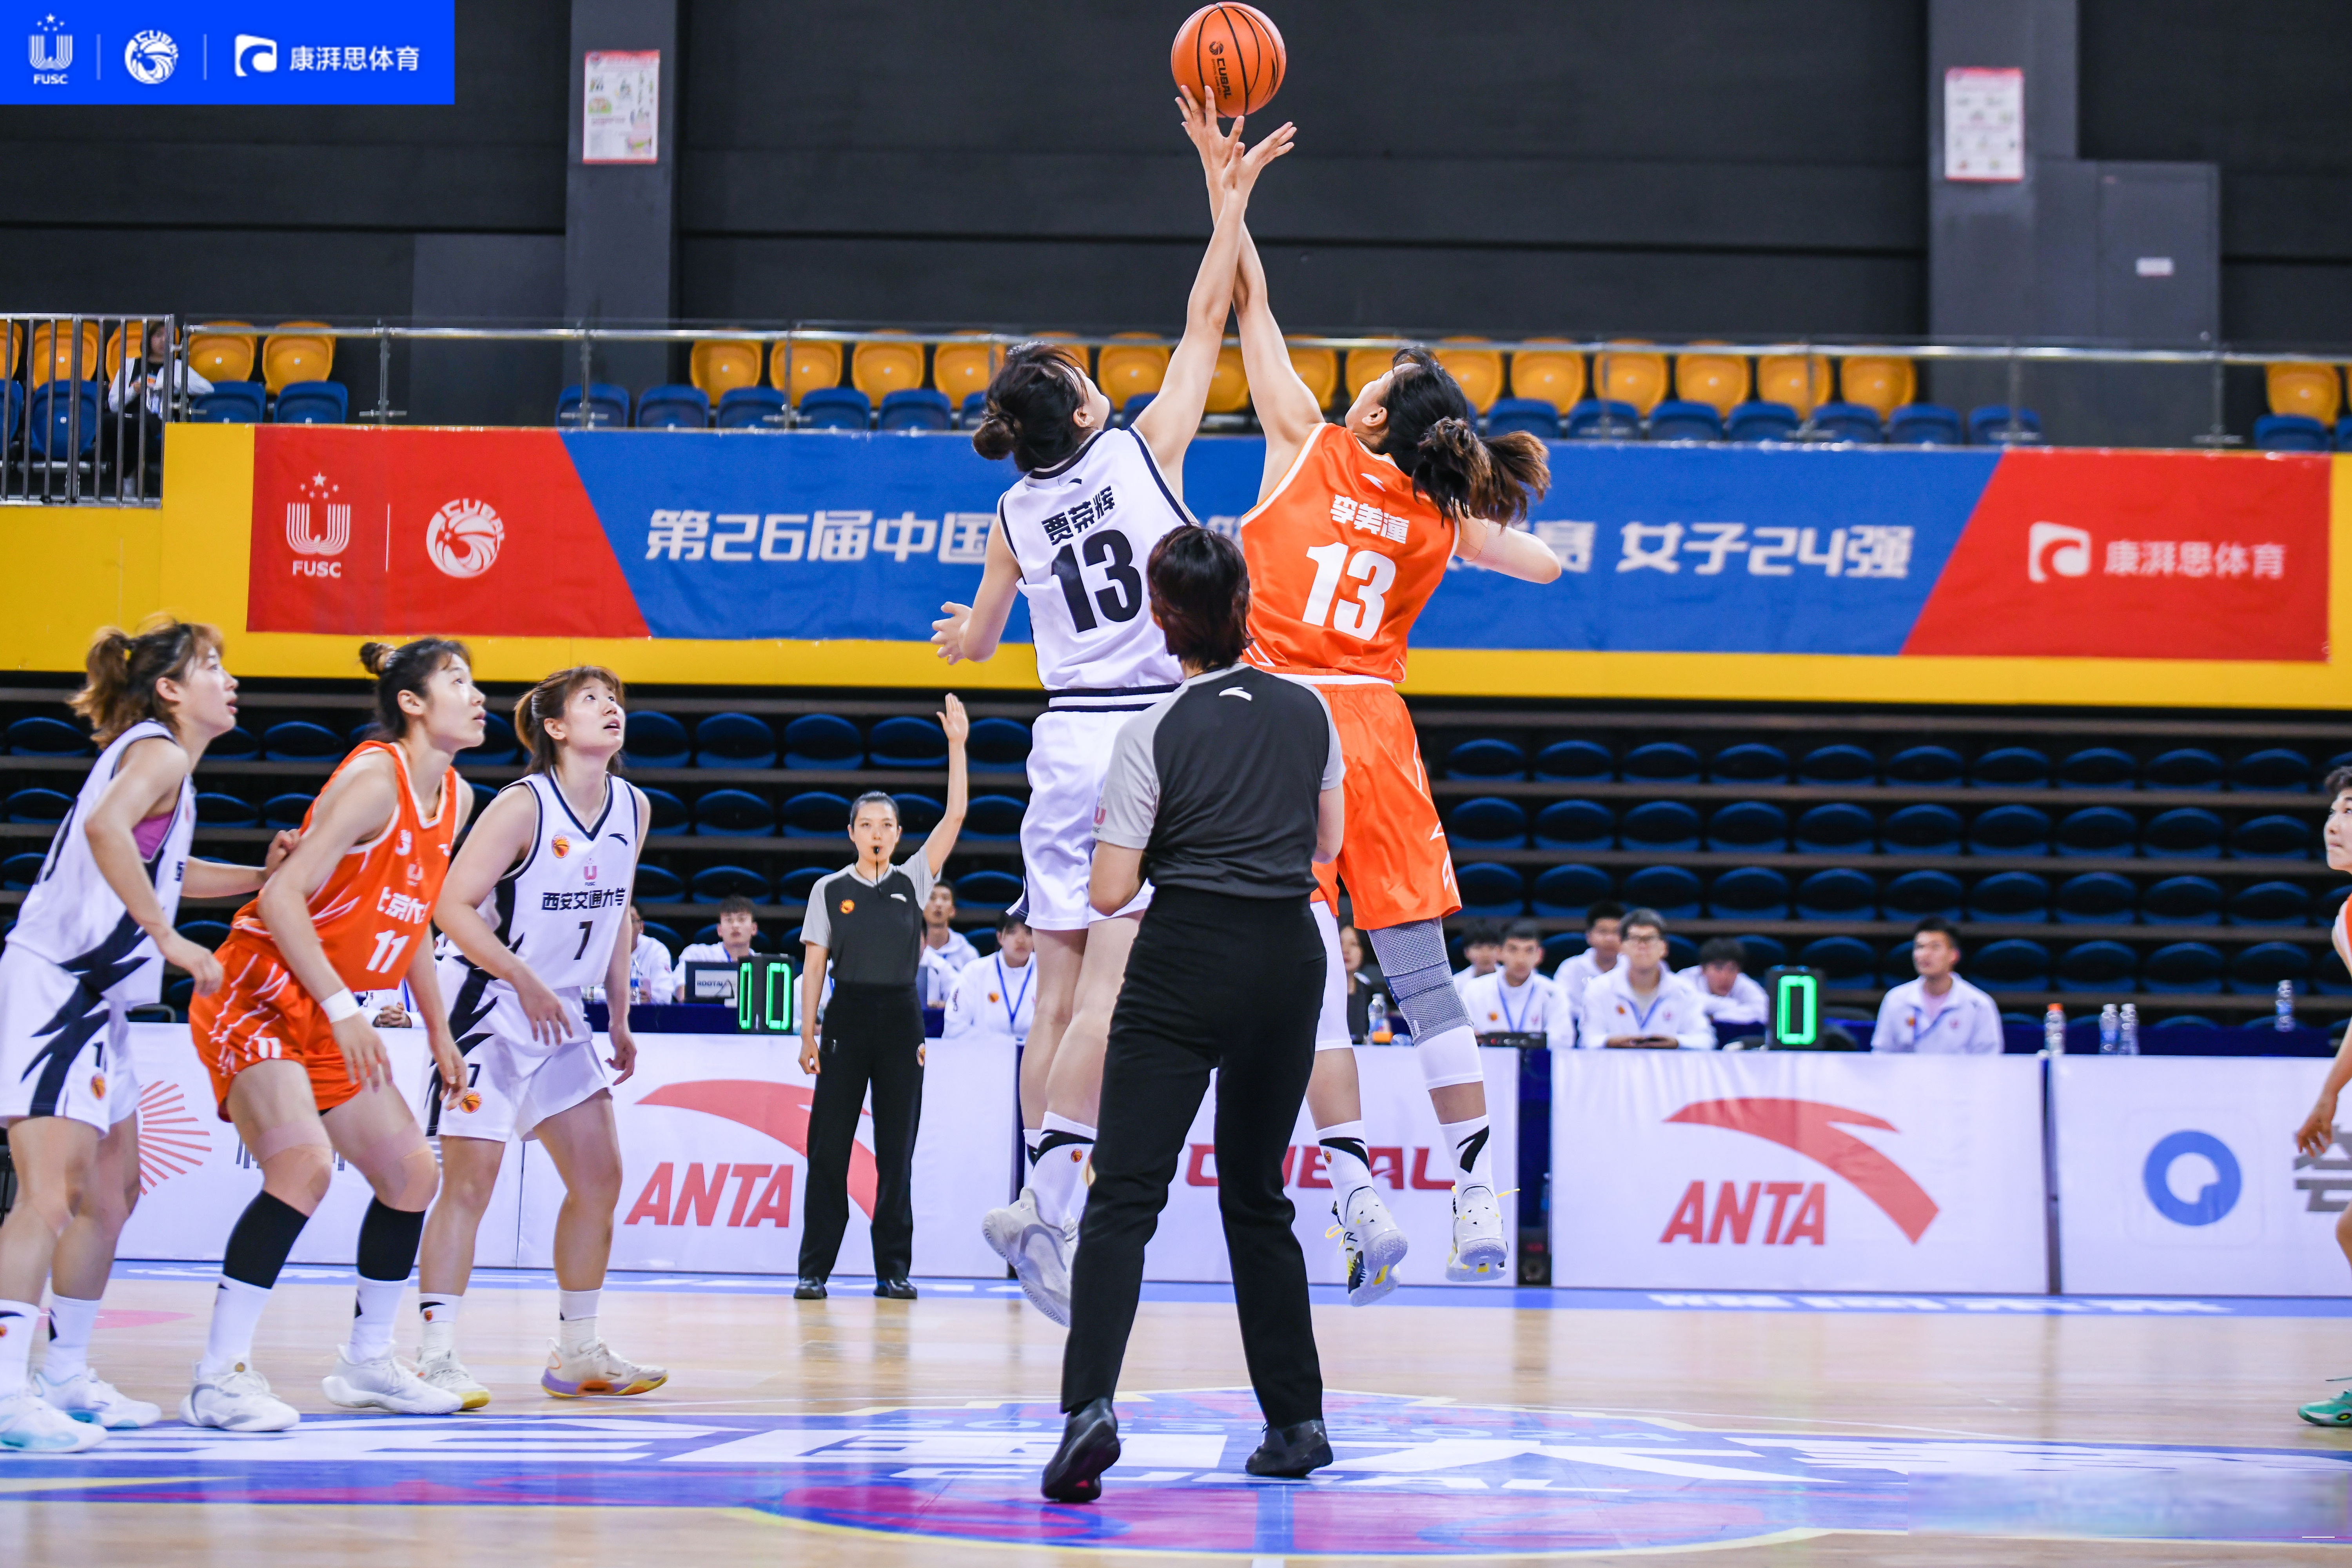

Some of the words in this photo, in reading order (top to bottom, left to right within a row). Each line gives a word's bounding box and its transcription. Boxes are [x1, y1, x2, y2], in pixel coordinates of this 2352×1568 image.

[1217, 58, 1231, 100] CUBAL
[292, 561, 341, 578] FUSC
[1615, 522, 1914, 578] 女子24强
[2103, 539, 2286, 580] 康湃思体育
[1051, 529, 1142, 633] 13
[1301, 541, 1396, 641] 13
[366, 929, 410, 973] 11
[573, 920, 593, 960] 7
[1777, 975, 1817, 1044] 0
[467, 1063, 481, 1088] 7
[1185, 1143, 1455, 1190] CBAL
[624, 1162, 793, 1228] ANTA
[1659, 1181, 1826, 1245] ANTA
